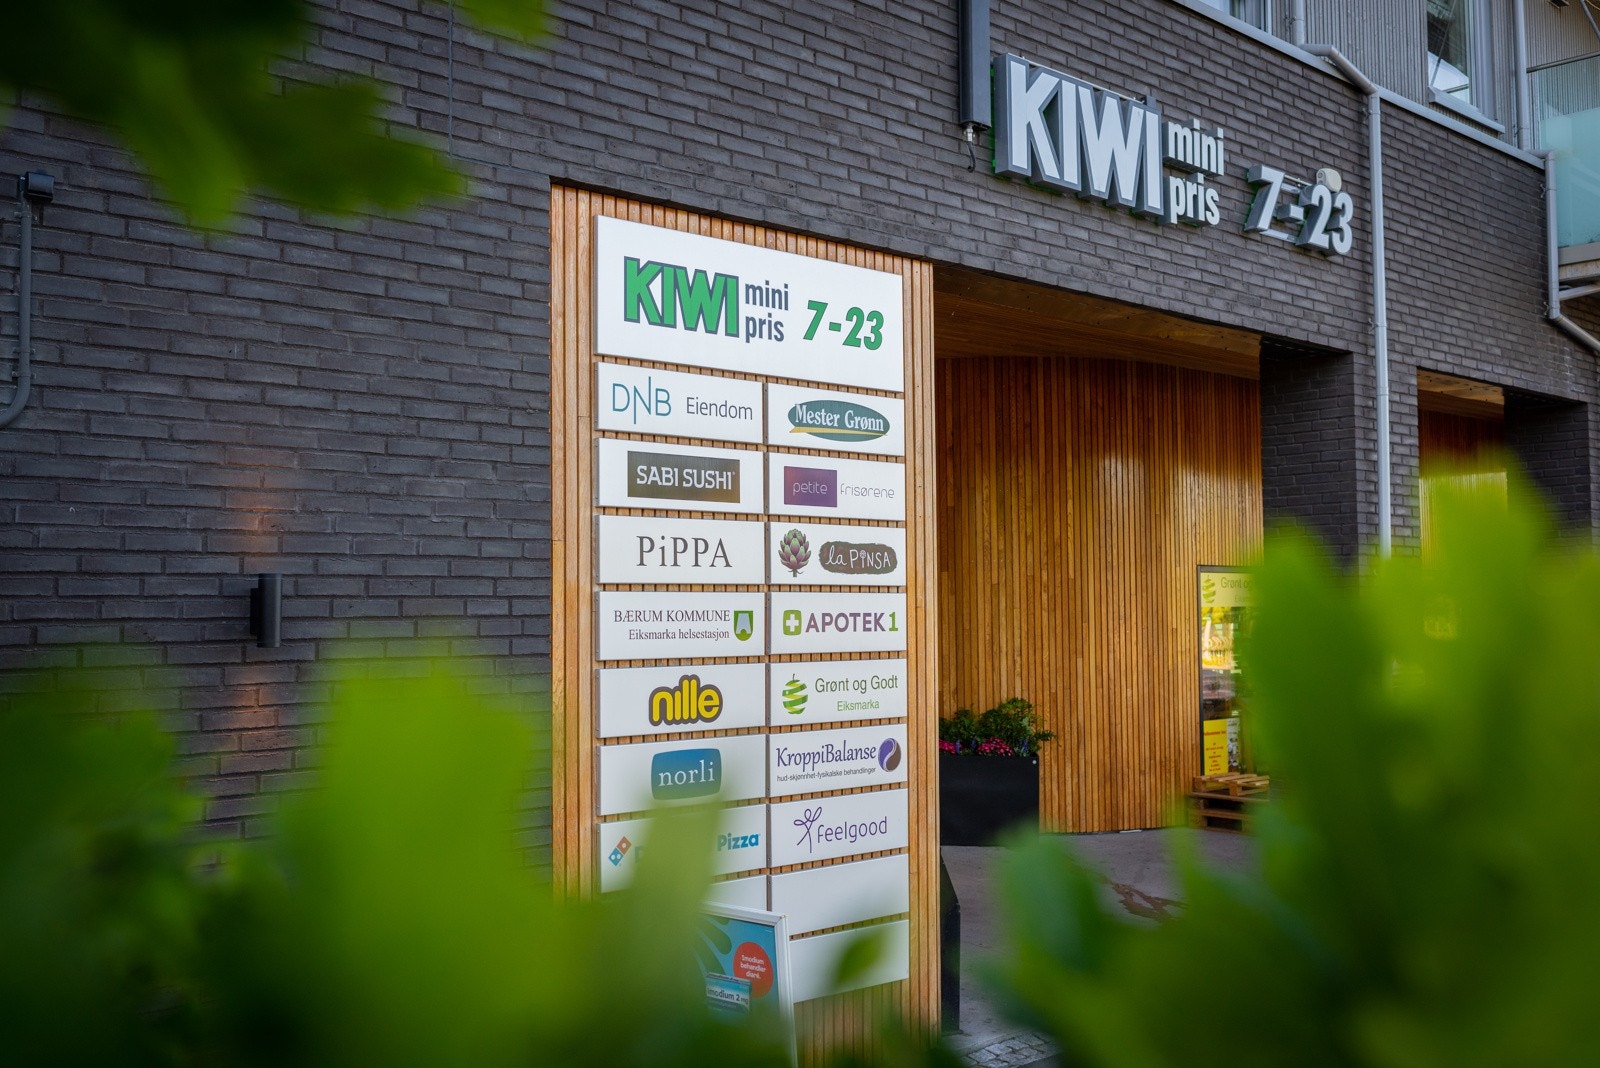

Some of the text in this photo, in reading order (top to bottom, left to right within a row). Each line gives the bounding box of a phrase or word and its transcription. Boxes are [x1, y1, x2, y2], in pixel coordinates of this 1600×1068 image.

[1002, 53, 1164, 215] KIWI
[1167, 119, 1224, 177] mini
[1169, 174, 1220, 226] pris
[1249, 166, 1354, 255] 7-23
[623, 255, 740, 339] KIWI
[744, 280, 789, 311] mini
[744, 312, 785, 343] pris
[803, 299, 885, 351] 7-23
[612, 376, 753, 424] DNB Eiendom
[794, 403, 885, 432] Mester Grønn
[636, 465, 732, 490] SABI SUSHI
[792, 480, 895, 499] petite frisørene
[636, 535, 733, 568] PiPPA
[825, 544, 848, 566] la
[614, 609, 731, 623] BÆRUM KOMMUNE
[628, 628, 730, 642] Eiksmarka helsestasjon
[814, 674, 899, 696] Grønt og Godt
[650, 675, 723, 726] nille
[836, 698, 880, 712] Eiksmarka
[775, 740, 877, 772] KroppiBalanse
[843, 766, 877, 776] behandlinger
[658, 760, 716, 786] norli
[717, 832, 759, 851] Pizza
[816, 816, 888, 843] feelgood
